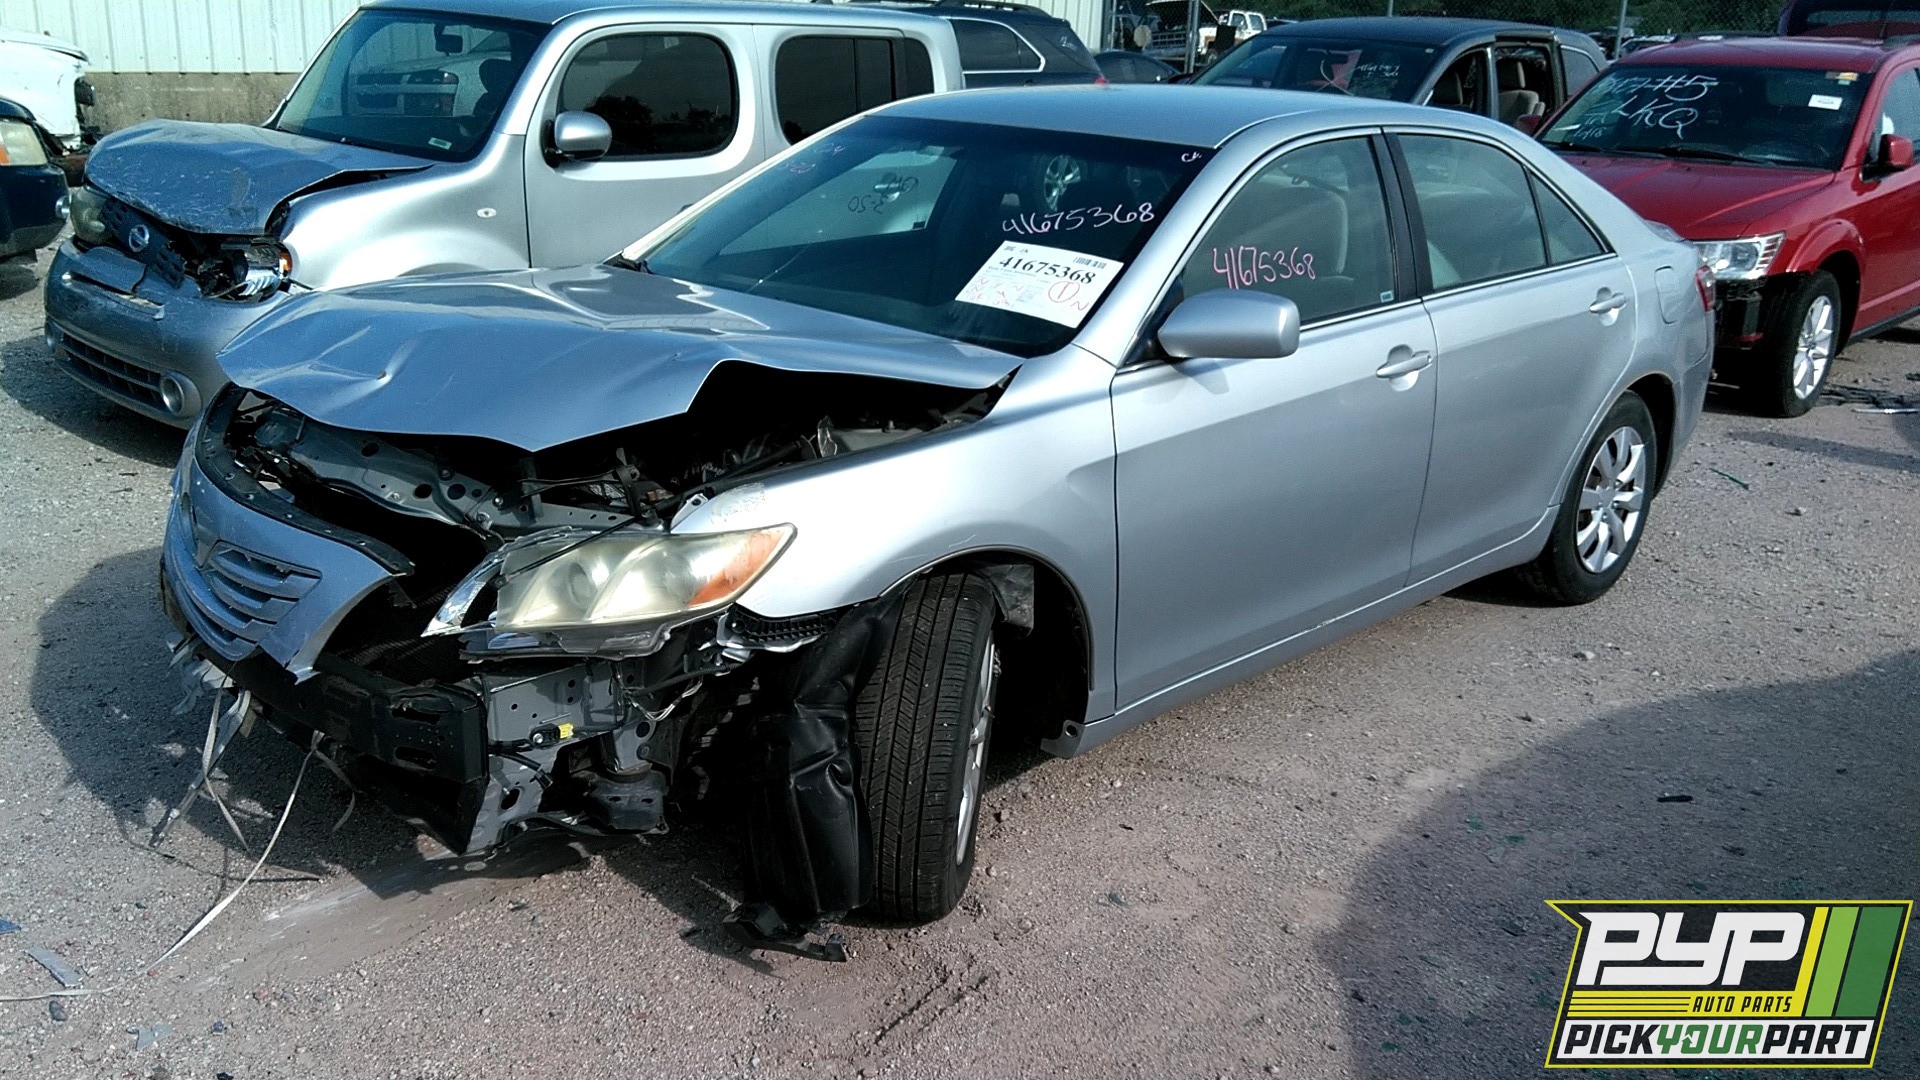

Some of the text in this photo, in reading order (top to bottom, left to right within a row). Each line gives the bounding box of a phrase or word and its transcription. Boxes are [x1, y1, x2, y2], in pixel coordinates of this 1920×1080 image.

[1611, 95, 1699, 140] LKQ
[1002, 202, 1155, 235] 41675368
[999, 256, 1096, 285] 41675368
[1213, 245, 1316, 291] 41675368
